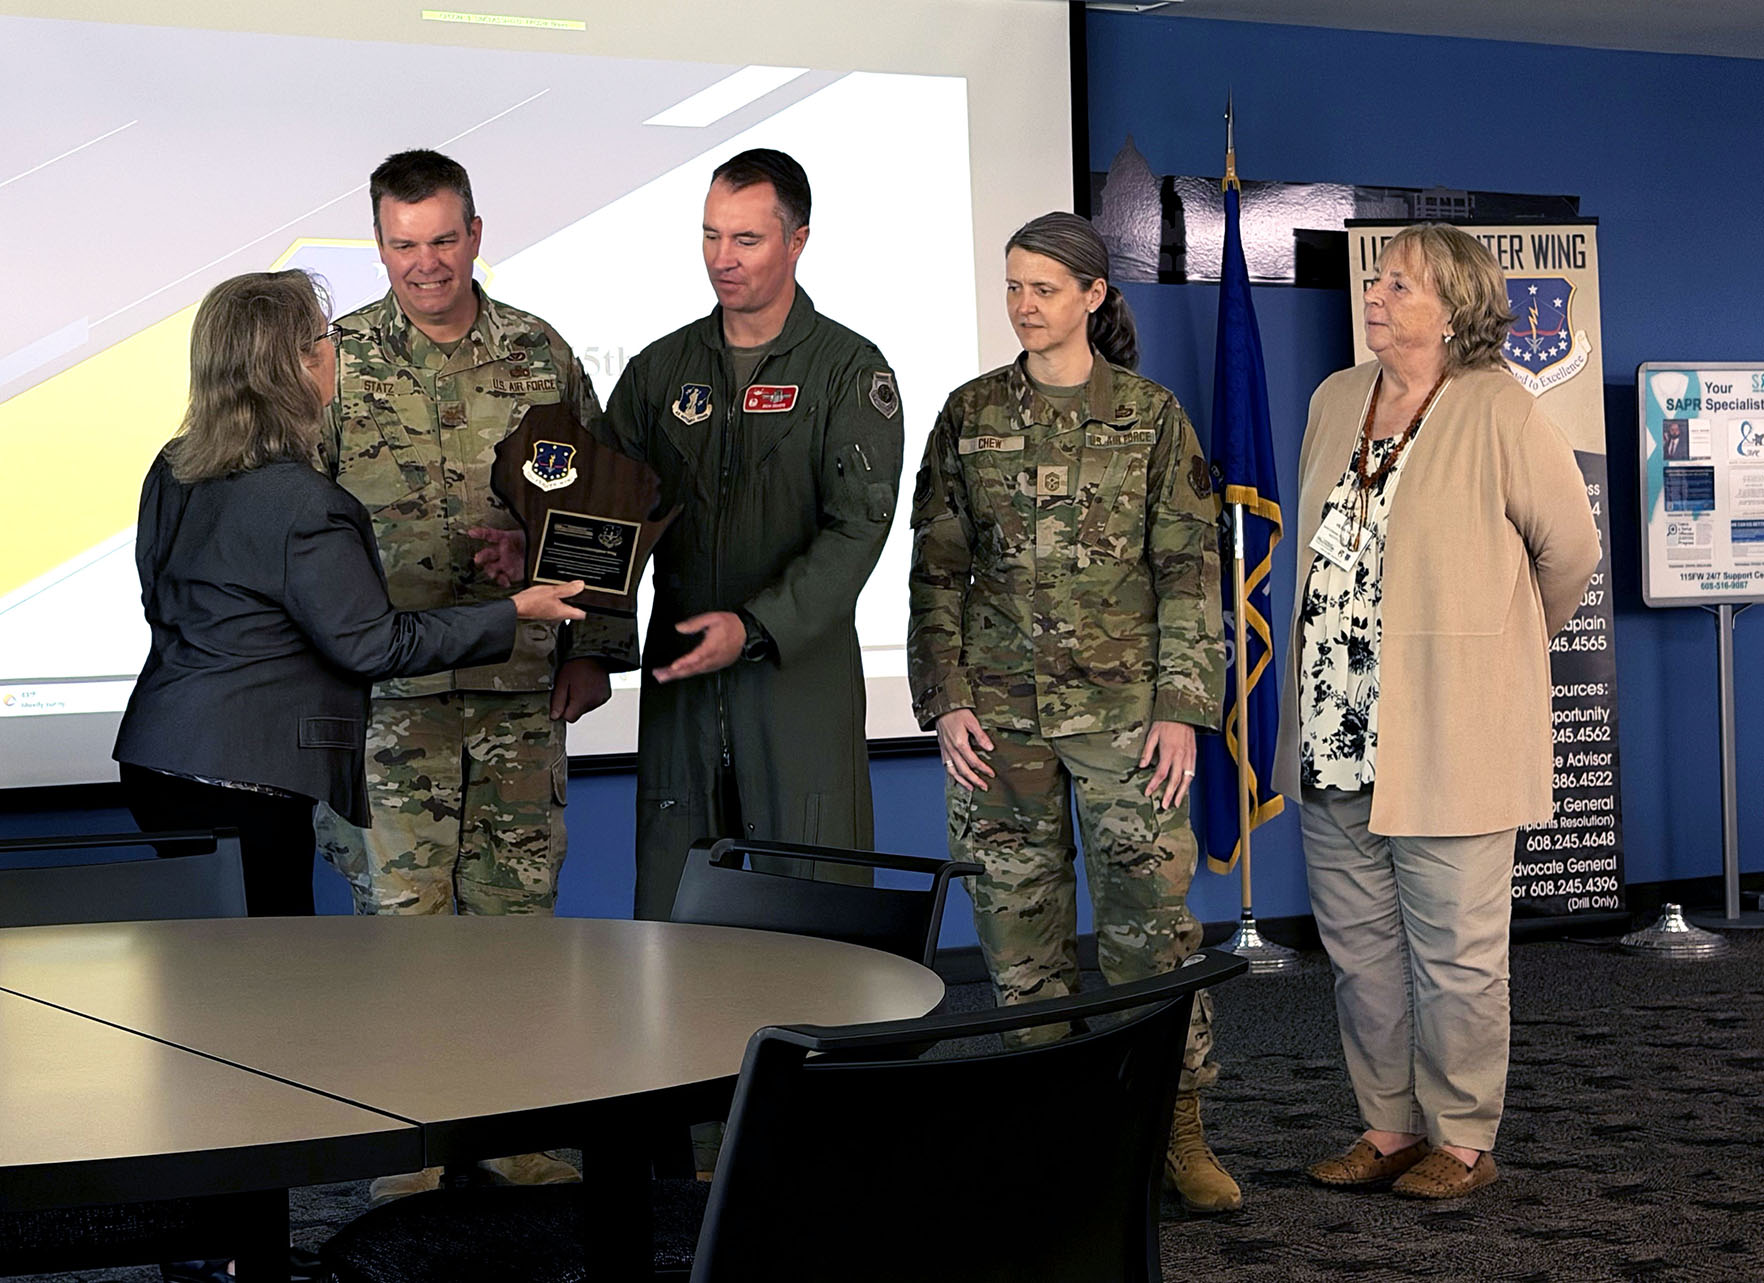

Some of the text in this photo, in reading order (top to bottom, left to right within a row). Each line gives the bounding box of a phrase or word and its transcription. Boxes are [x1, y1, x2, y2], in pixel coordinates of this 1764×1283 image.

[1360, 235, 1394, 271] 11
[1530, 233, 1586, 269] WING
[1539, 355, 1584, 388] Excellence
[363, 380, 394, 393] STATZ
[509, 382, 523, 391] AIR
[526, 378, 556, 391] FORCE
[1705, 381, 1733, 394] Your
[1666, 398, 1702, 411] SAPR
[978, 437, 1002, 449] CHEW
[1123, 431, 1152, 444] FORCE
[1706, 572, 1721, 580] 24/7
[1723, 571, 1753, 582] Support
[1561, 614, 1606, 634] aplain
[1566, 751, 1612, 768] Advisor
[1563, 794, 1614, 812] General
[1560, 814, 1615, 828] Resolution)
[1526, 831, 1616, 852] 608.245.4648
[1566, 855, 1617, 873] General
[1530, 875, 1618, 897] 608.245.4396
[1567, 895, 1619, 912] (Drill Only)
